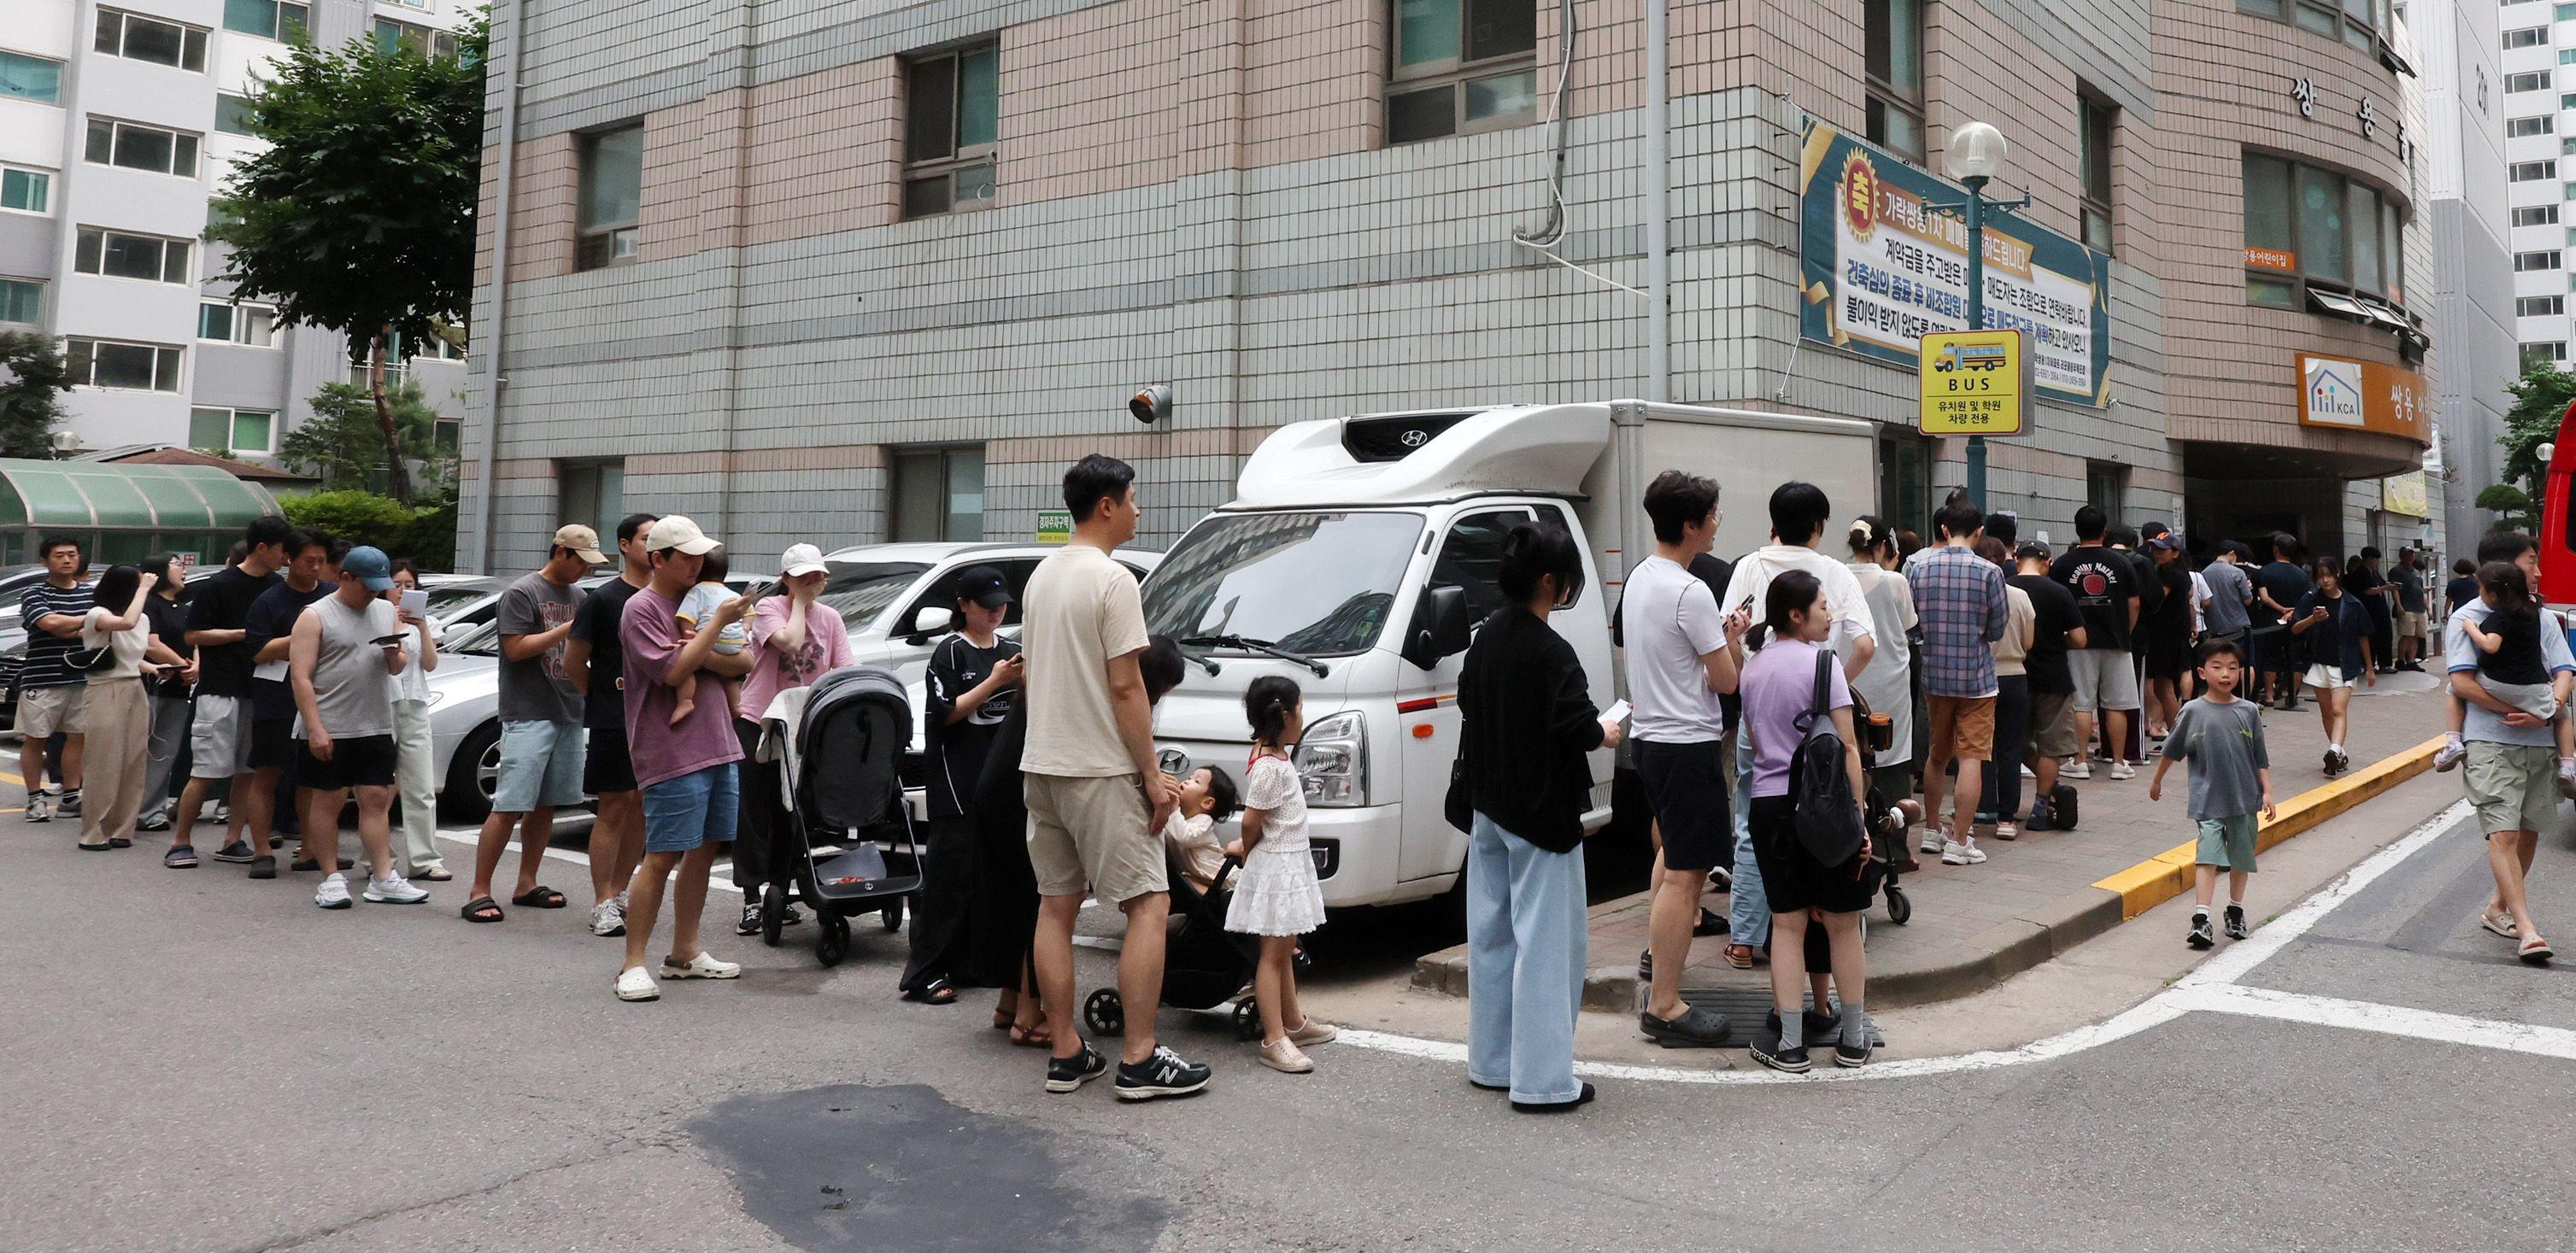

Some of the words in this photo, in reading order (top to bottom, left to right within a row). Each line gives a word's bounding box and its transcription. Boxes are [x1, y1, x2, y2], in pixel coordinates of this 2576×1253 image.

[1852, 171, 1869, 220] 축
[1981, 233, 2027, 272] 하드립니다.
[1846, 258, 1890, 297] 건축심의
[1892, 274, 1912, 304] 종료
[1913, 282, 1923, 307] 후
[1926, 286, 1961, 320] 비조합원
[1885, 237, 1923, 274] 계약금을
[1926, 253, 1961, 287] 주고받은
[1987, 276, 2017, 307] 매도자는
[2019, 287, 2047, 315] 조합으로
[1846, 295, 1878, 330] 불이익
[1880, 306, 1899, 336] 받지
[1949, 378, 1990, 391] BUS
[2391, 384, 2415, 422] 쌍용
[1938, 401, 1966, 412] 유치원
[1969, 401, 1979, 412] 및
[1981, 400, 2001, 412] 학원
[1949, 413, 1968, 424] 차량
[1970, 413, 1990, 424] 전용
[2337, 403, 2355, 415] KCA
[2094, 562, 2118, 584] Market
